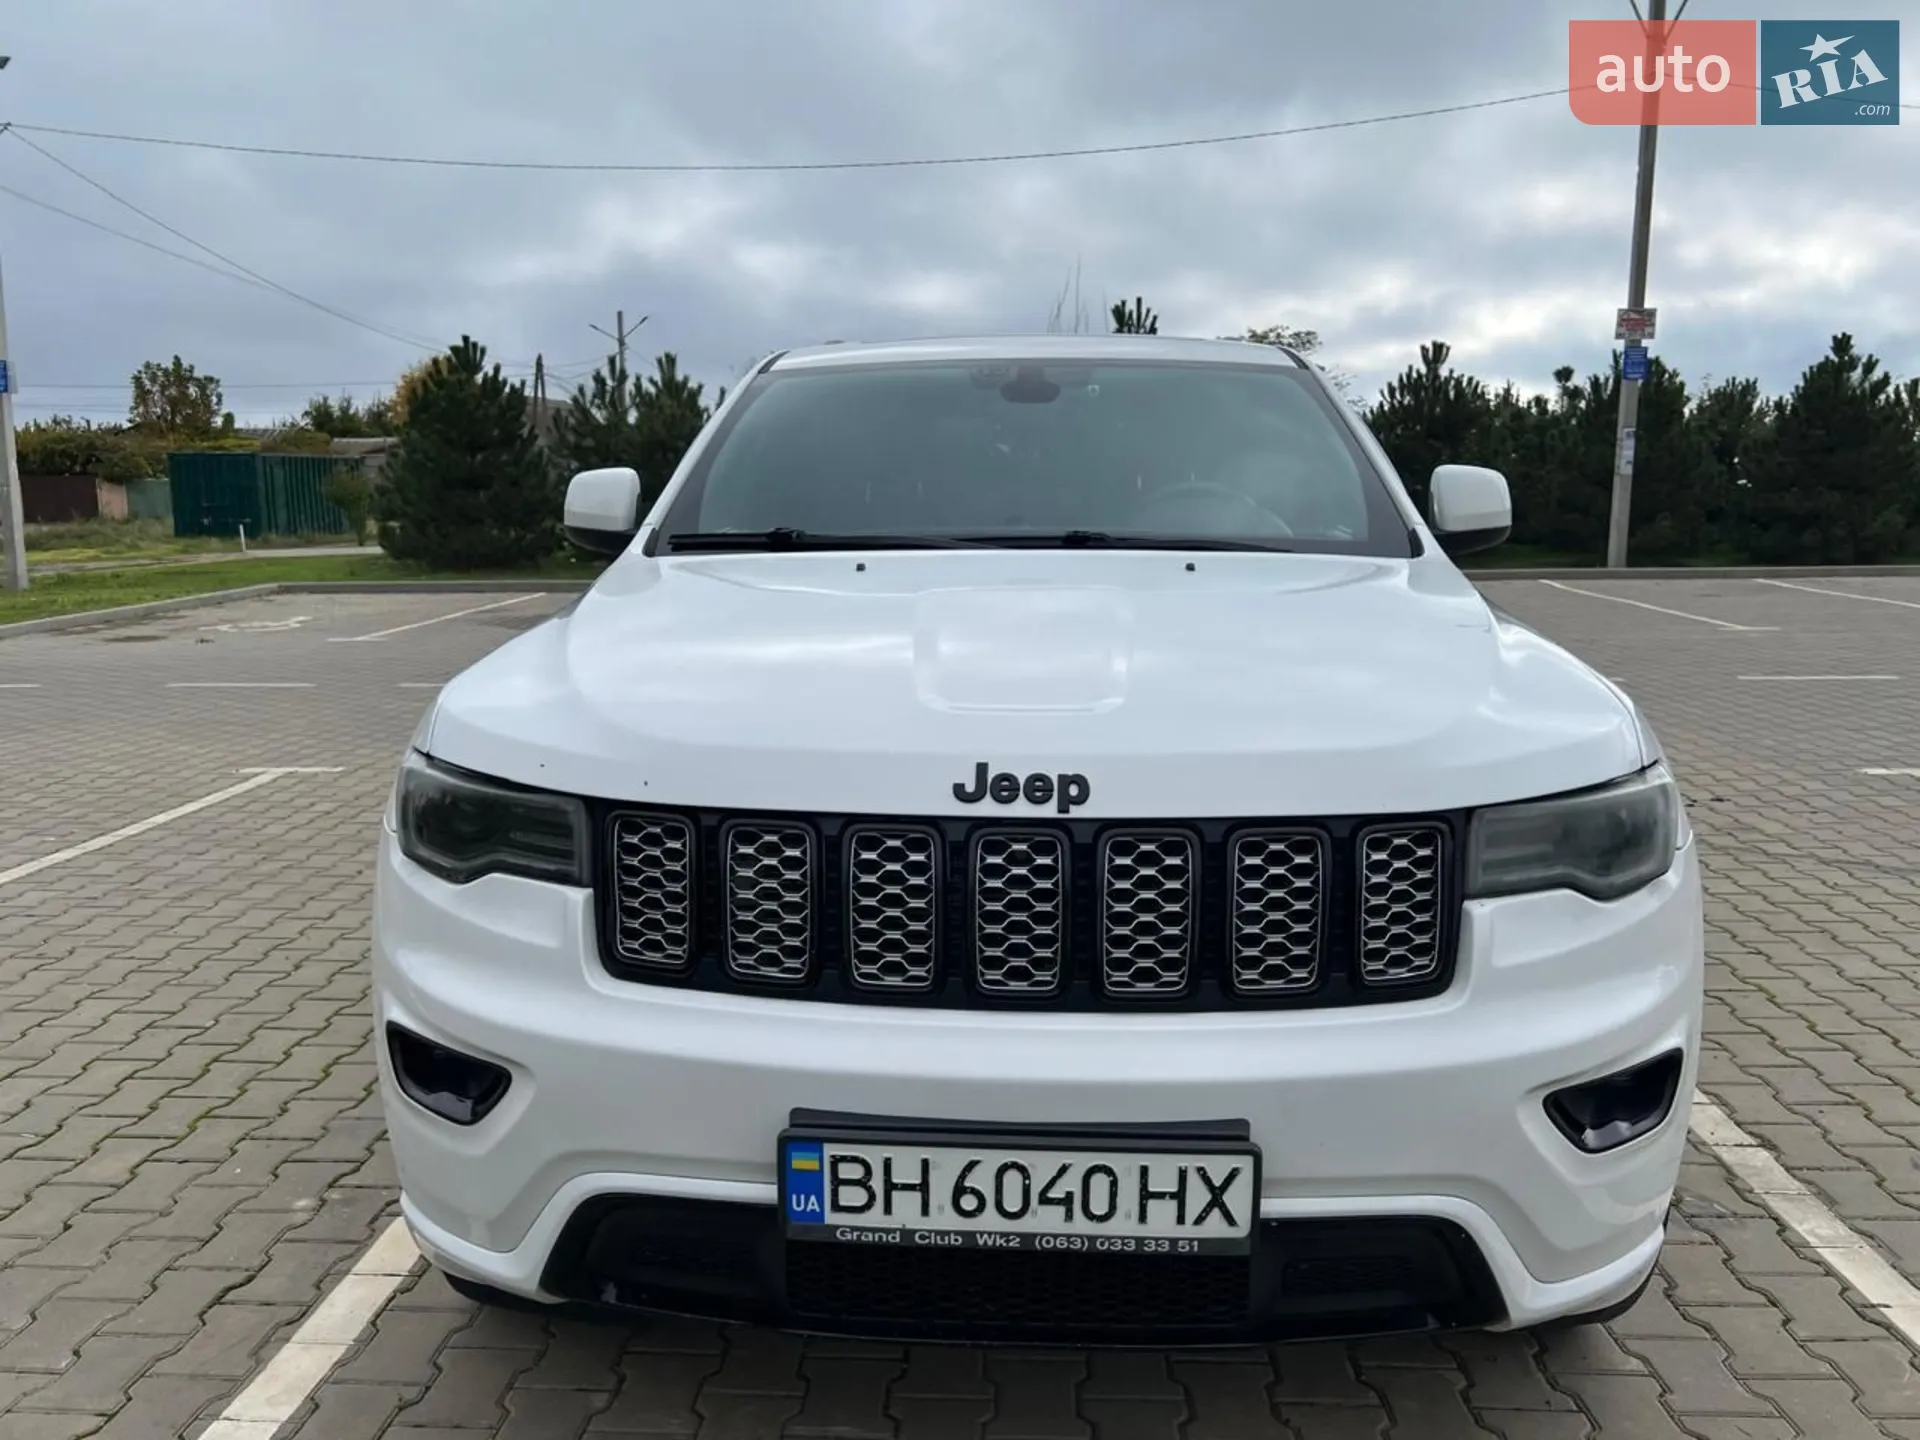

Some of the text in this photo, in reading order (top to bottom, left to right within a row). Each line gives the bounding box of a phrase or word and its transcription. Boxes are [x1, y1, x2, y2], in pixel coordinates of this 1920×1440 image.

[952, 762, 1090, 814] Jeep
[791, 1193, 820, 1213] UA
[829, 1154, 1244, 1227] BH 6040 HX
[835, 1227, 1199, 1253] Grand Club Wk2 (063) 033 33 51
